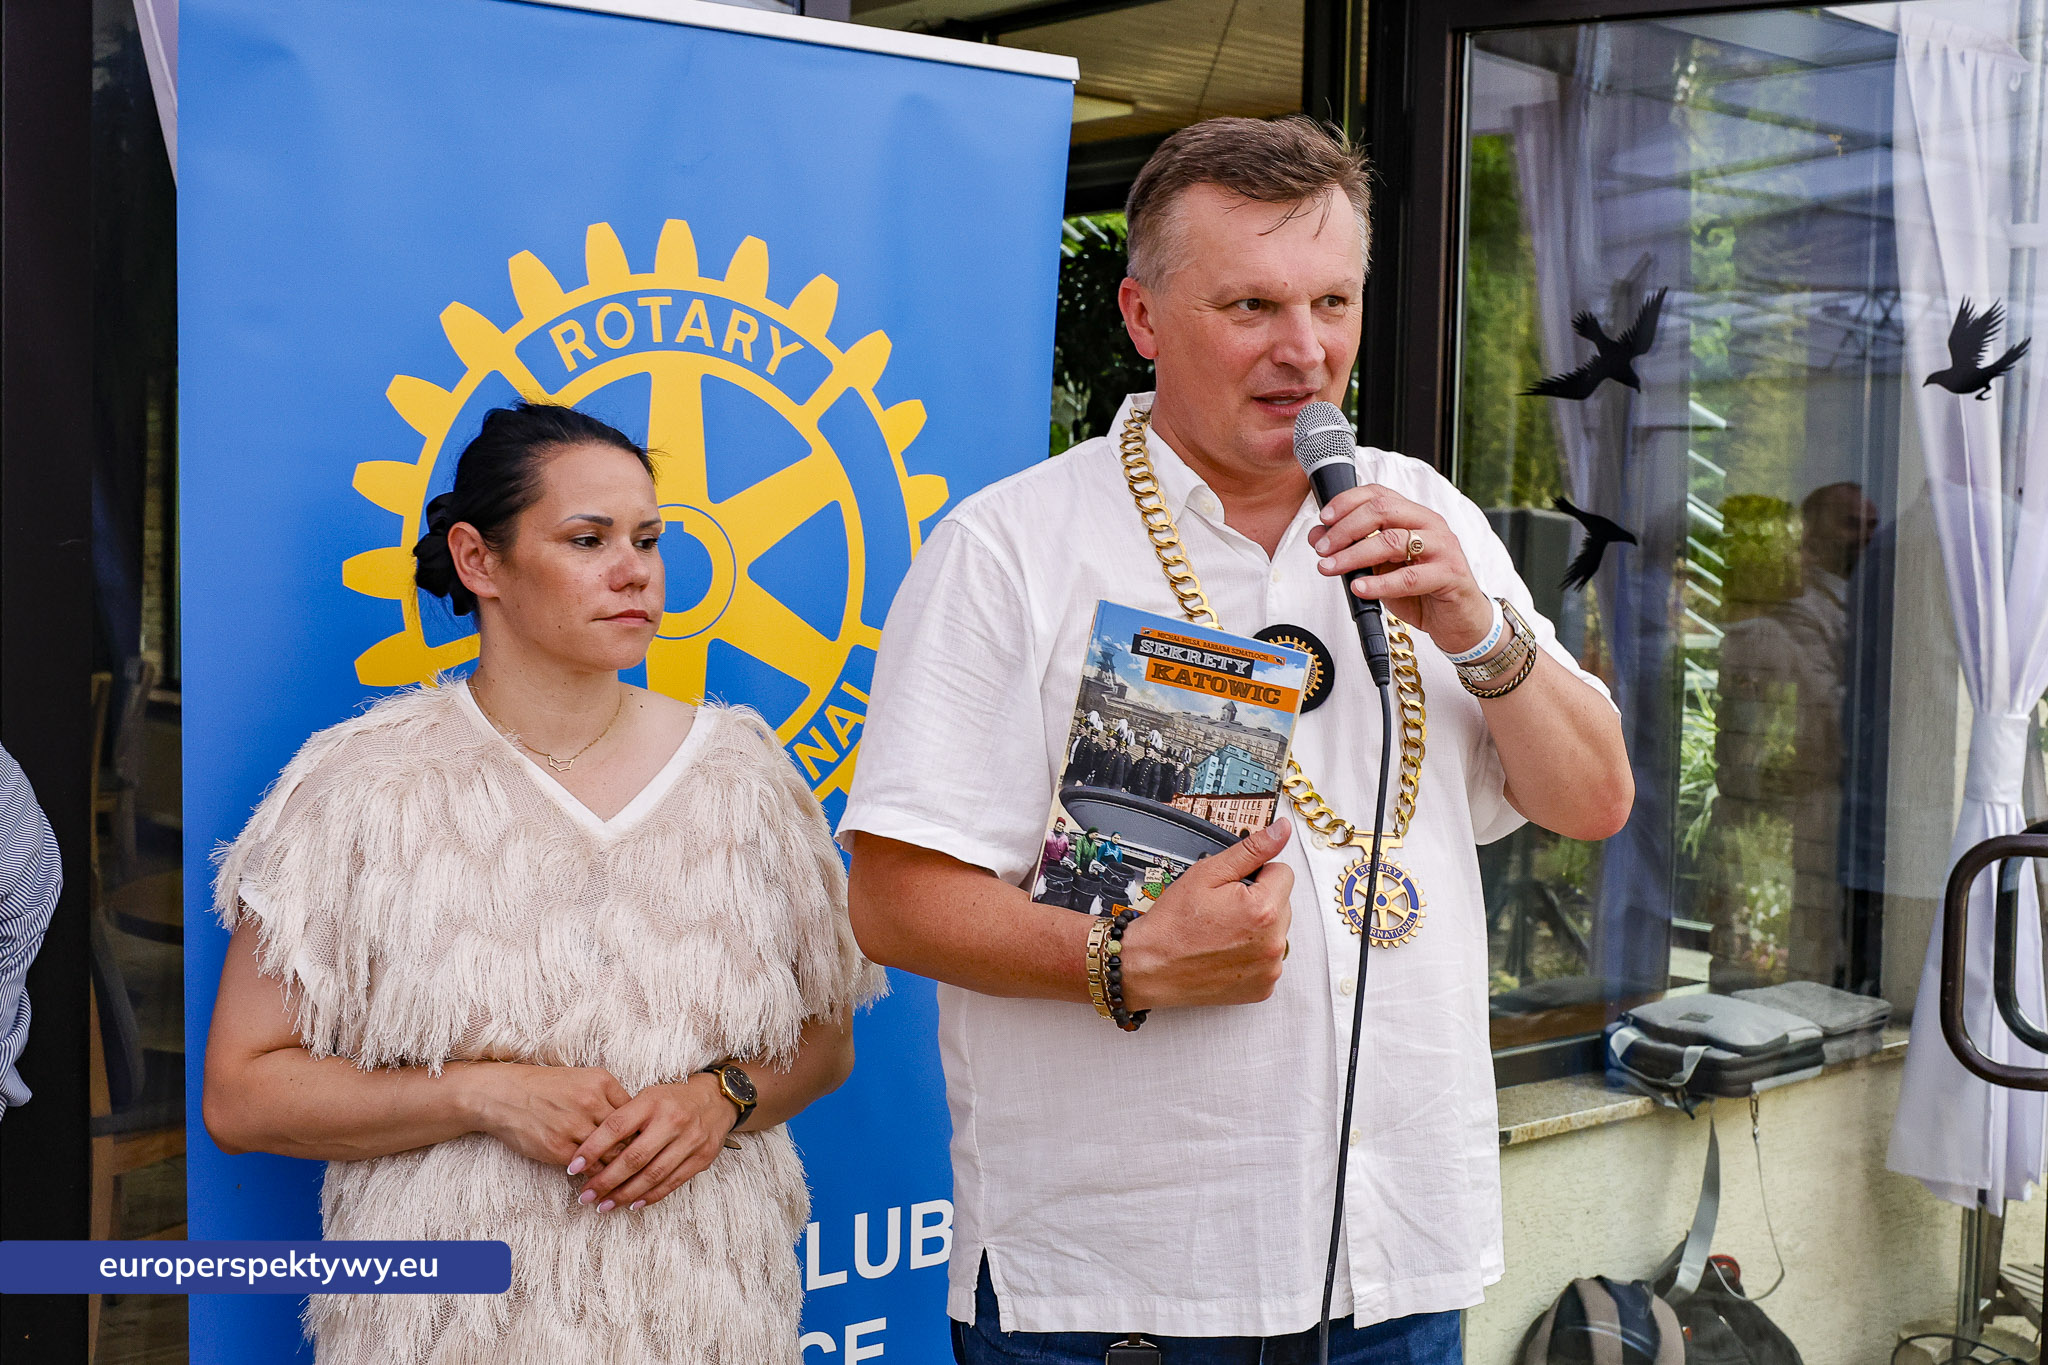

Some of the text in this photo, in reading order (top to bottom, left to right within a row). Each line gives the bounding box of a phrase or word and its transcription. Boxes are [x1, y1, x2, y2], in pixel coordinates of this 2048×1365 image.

[549, 296, 804, 376] ROTARY
[1139, 638, 1250, 675] SEKRETY
[1151, 662, 1282, 705] KATOWIC
[1359, 863, 1400, 877] ROARY
[1350, 911, 1417, 940] INTRNATIONAL
[806, 1199, 955, 1292] LUB
